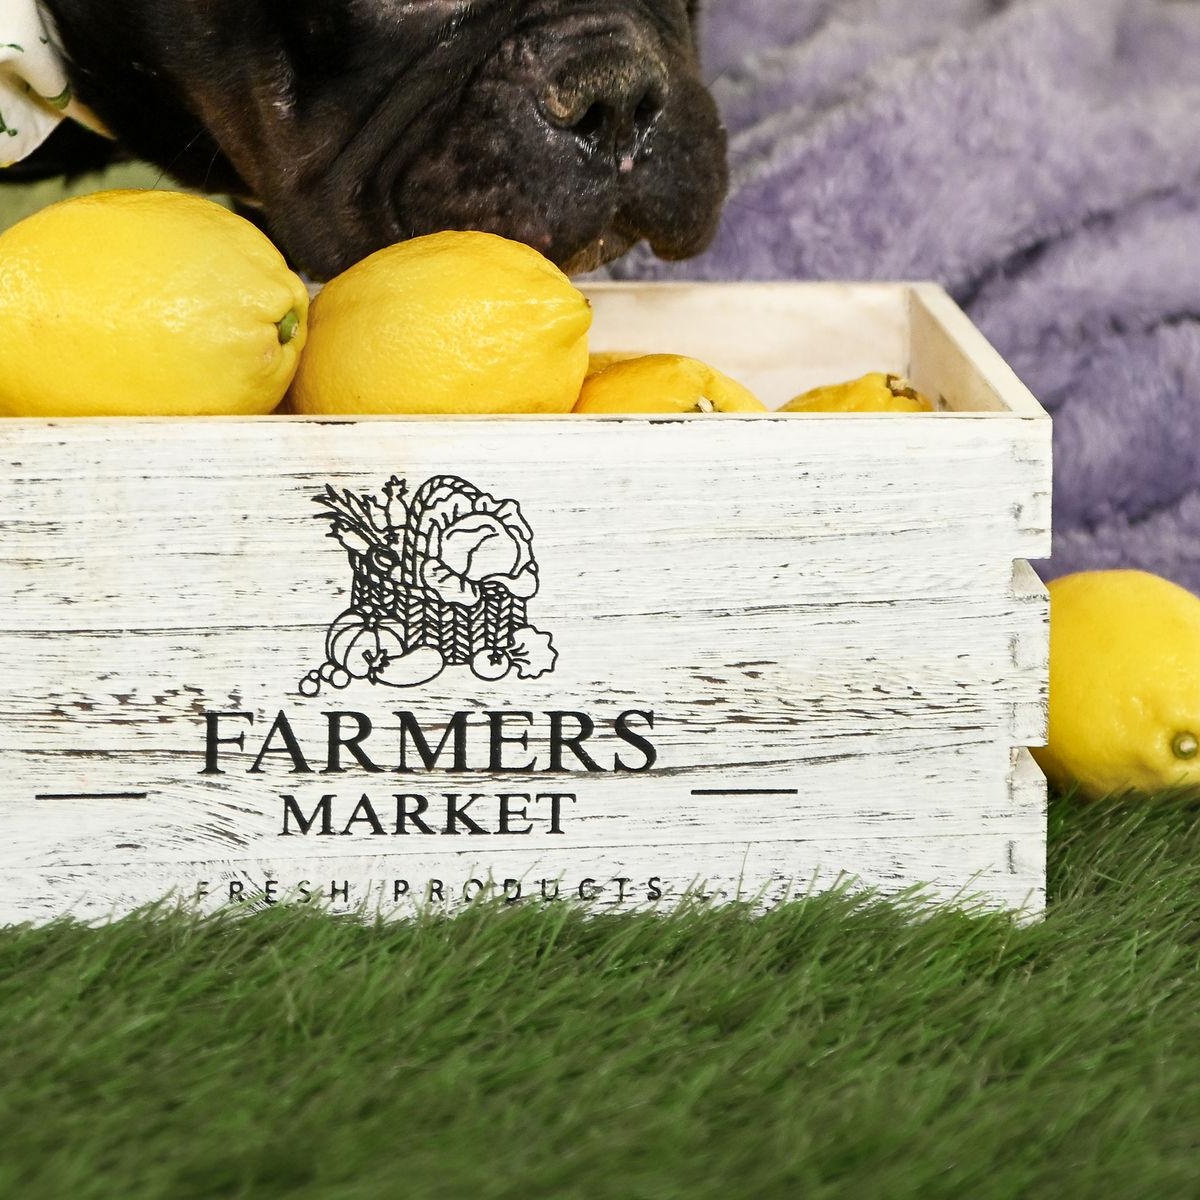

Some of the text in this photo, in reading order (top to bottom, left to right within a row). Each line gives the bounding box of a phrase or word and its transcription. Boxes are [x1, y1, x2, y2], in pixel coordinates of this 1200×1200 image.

[198, 709, 658, 774] FARMERS
[278, 792, 577, 836] MARKET
[197, 876, 662, 904] FRESH PRODUCTS
